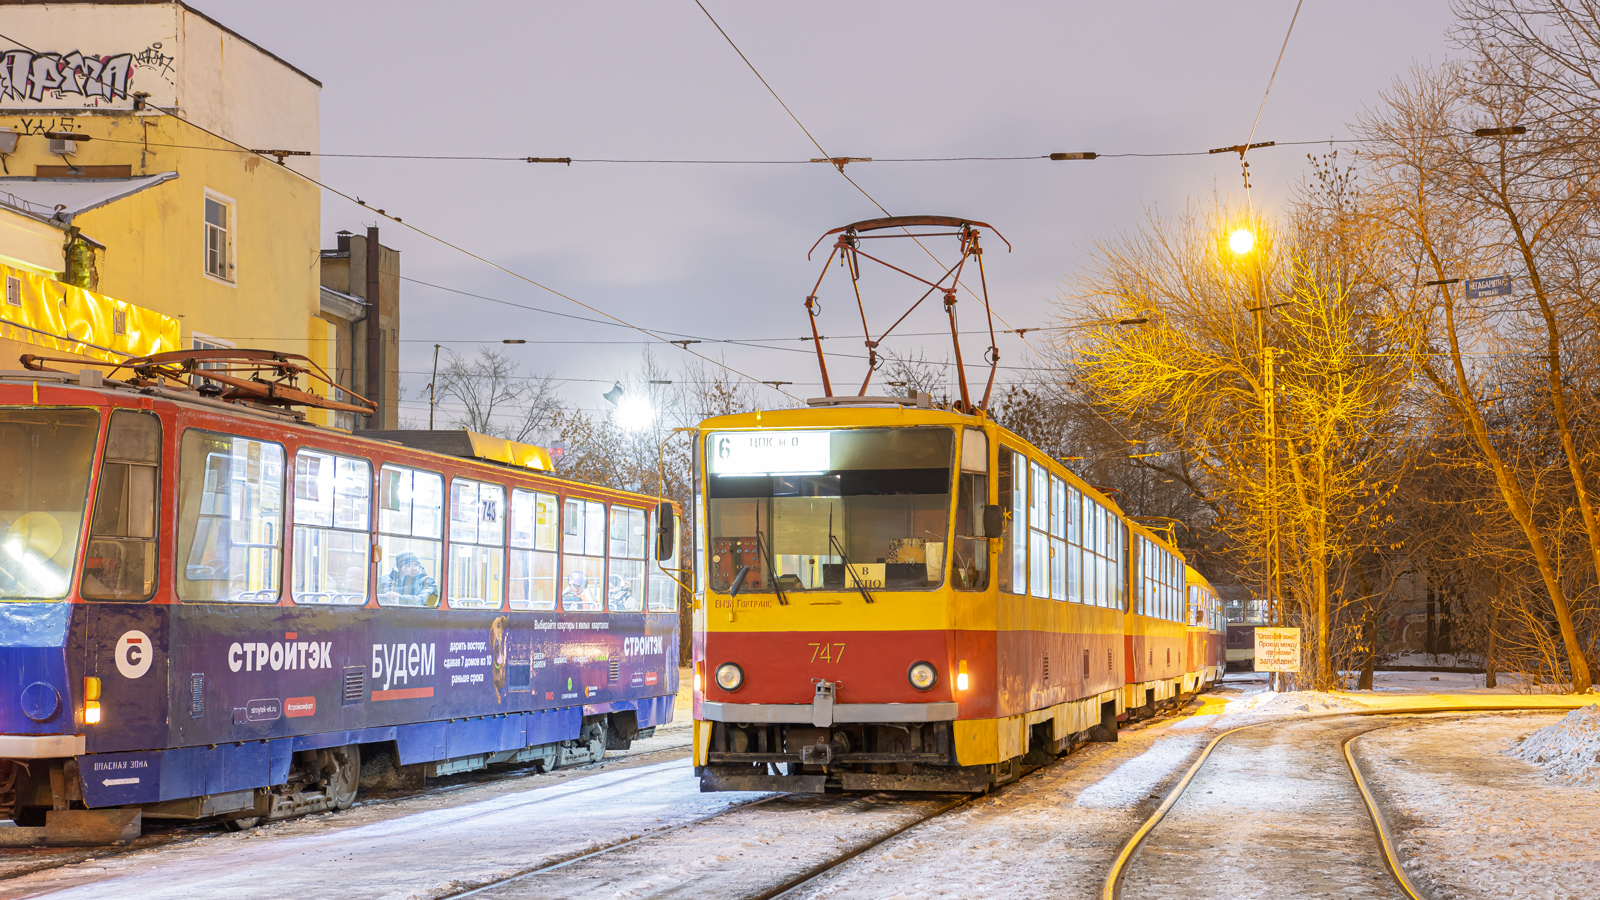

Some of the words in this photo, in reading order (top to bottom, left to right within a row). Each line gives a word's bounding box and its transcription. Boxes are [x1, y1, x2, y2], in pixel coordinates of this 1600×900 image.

[718, 437, 730, 459] 6
[749, 437, 773, 448] ЦПК
[482, 500, 497, 521] 743
[862, 566, 869, 576] В
[449, 641, 467, 653] дарить
[467, 641, 487, 653] восторг,
[1258, 640, 1280, 648] Проход
[228, 632, 333, 672] СТРОЙТЭК
[808, 642, 846, 663] 747
[371, 642, 436, 691] Будем
[443, 658, 461, 668] сдавая
[461, 655, 465, 667] 7
[464, 657, 480, 668] домов
[480, 657, 486, 666] из
[486, 654, 492, 666] 10
[451, 674, 470, 686] раньше
[470, 673, 484, 685] срока
[94, 761, 127, 771] ОПАСНАЯ
[130, 760, 148, 769] ЗОНА
